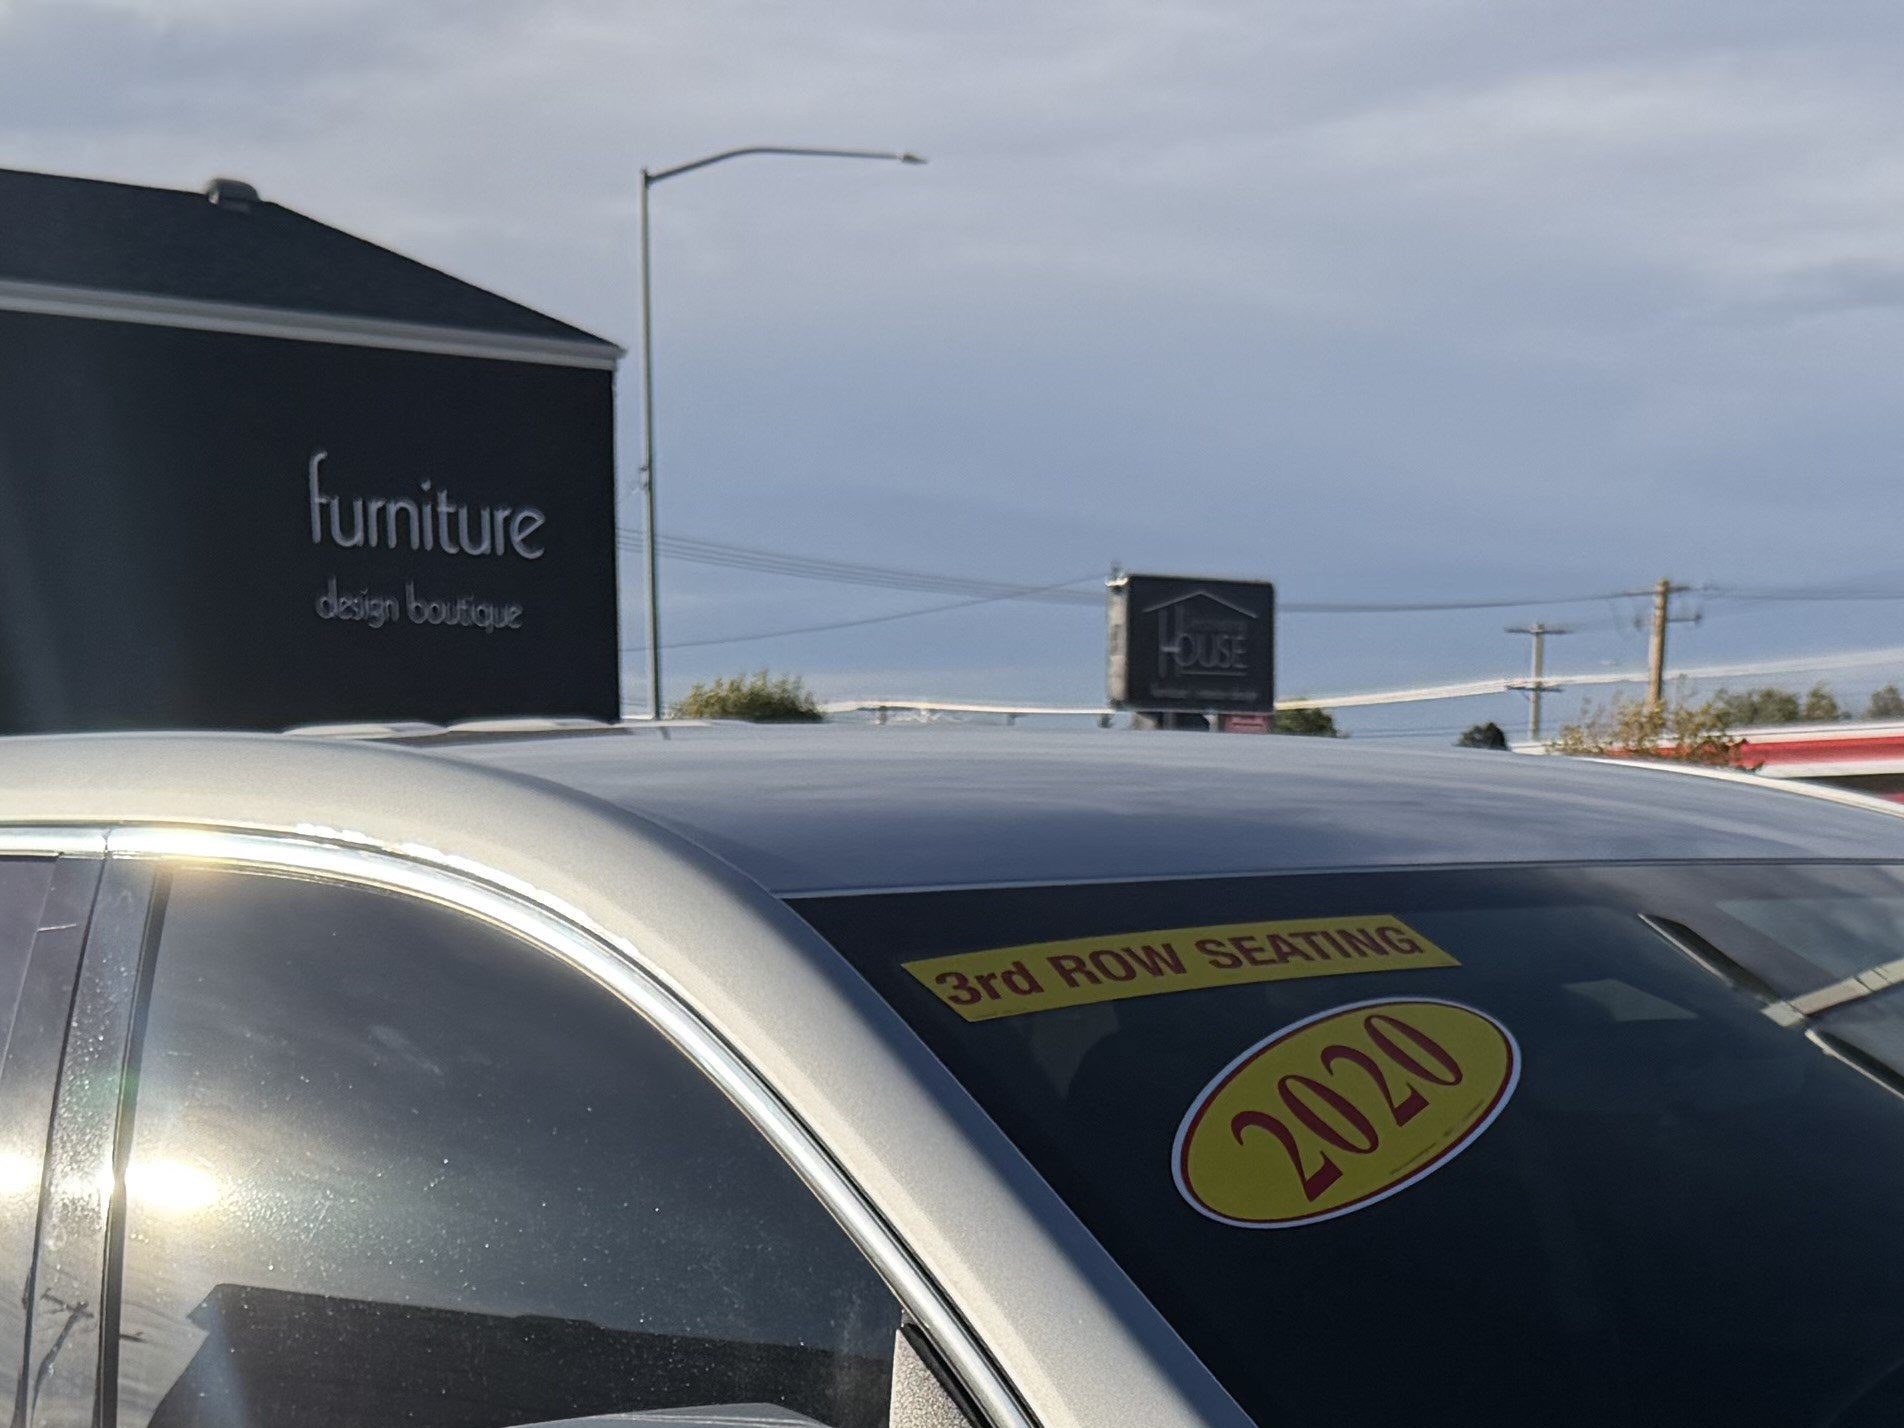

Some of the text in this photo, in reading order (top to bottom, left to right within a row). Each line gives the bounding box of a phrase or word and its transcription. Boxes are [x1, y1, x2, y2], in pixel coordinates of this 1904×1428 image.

[309, 450, 545, 560] furniture
[316, 574, 523, 635] design boutique
[935, 924, 1424, 1006] 3rd ROW SEATING
[1230, 1014, 1464, 1202] 2020
